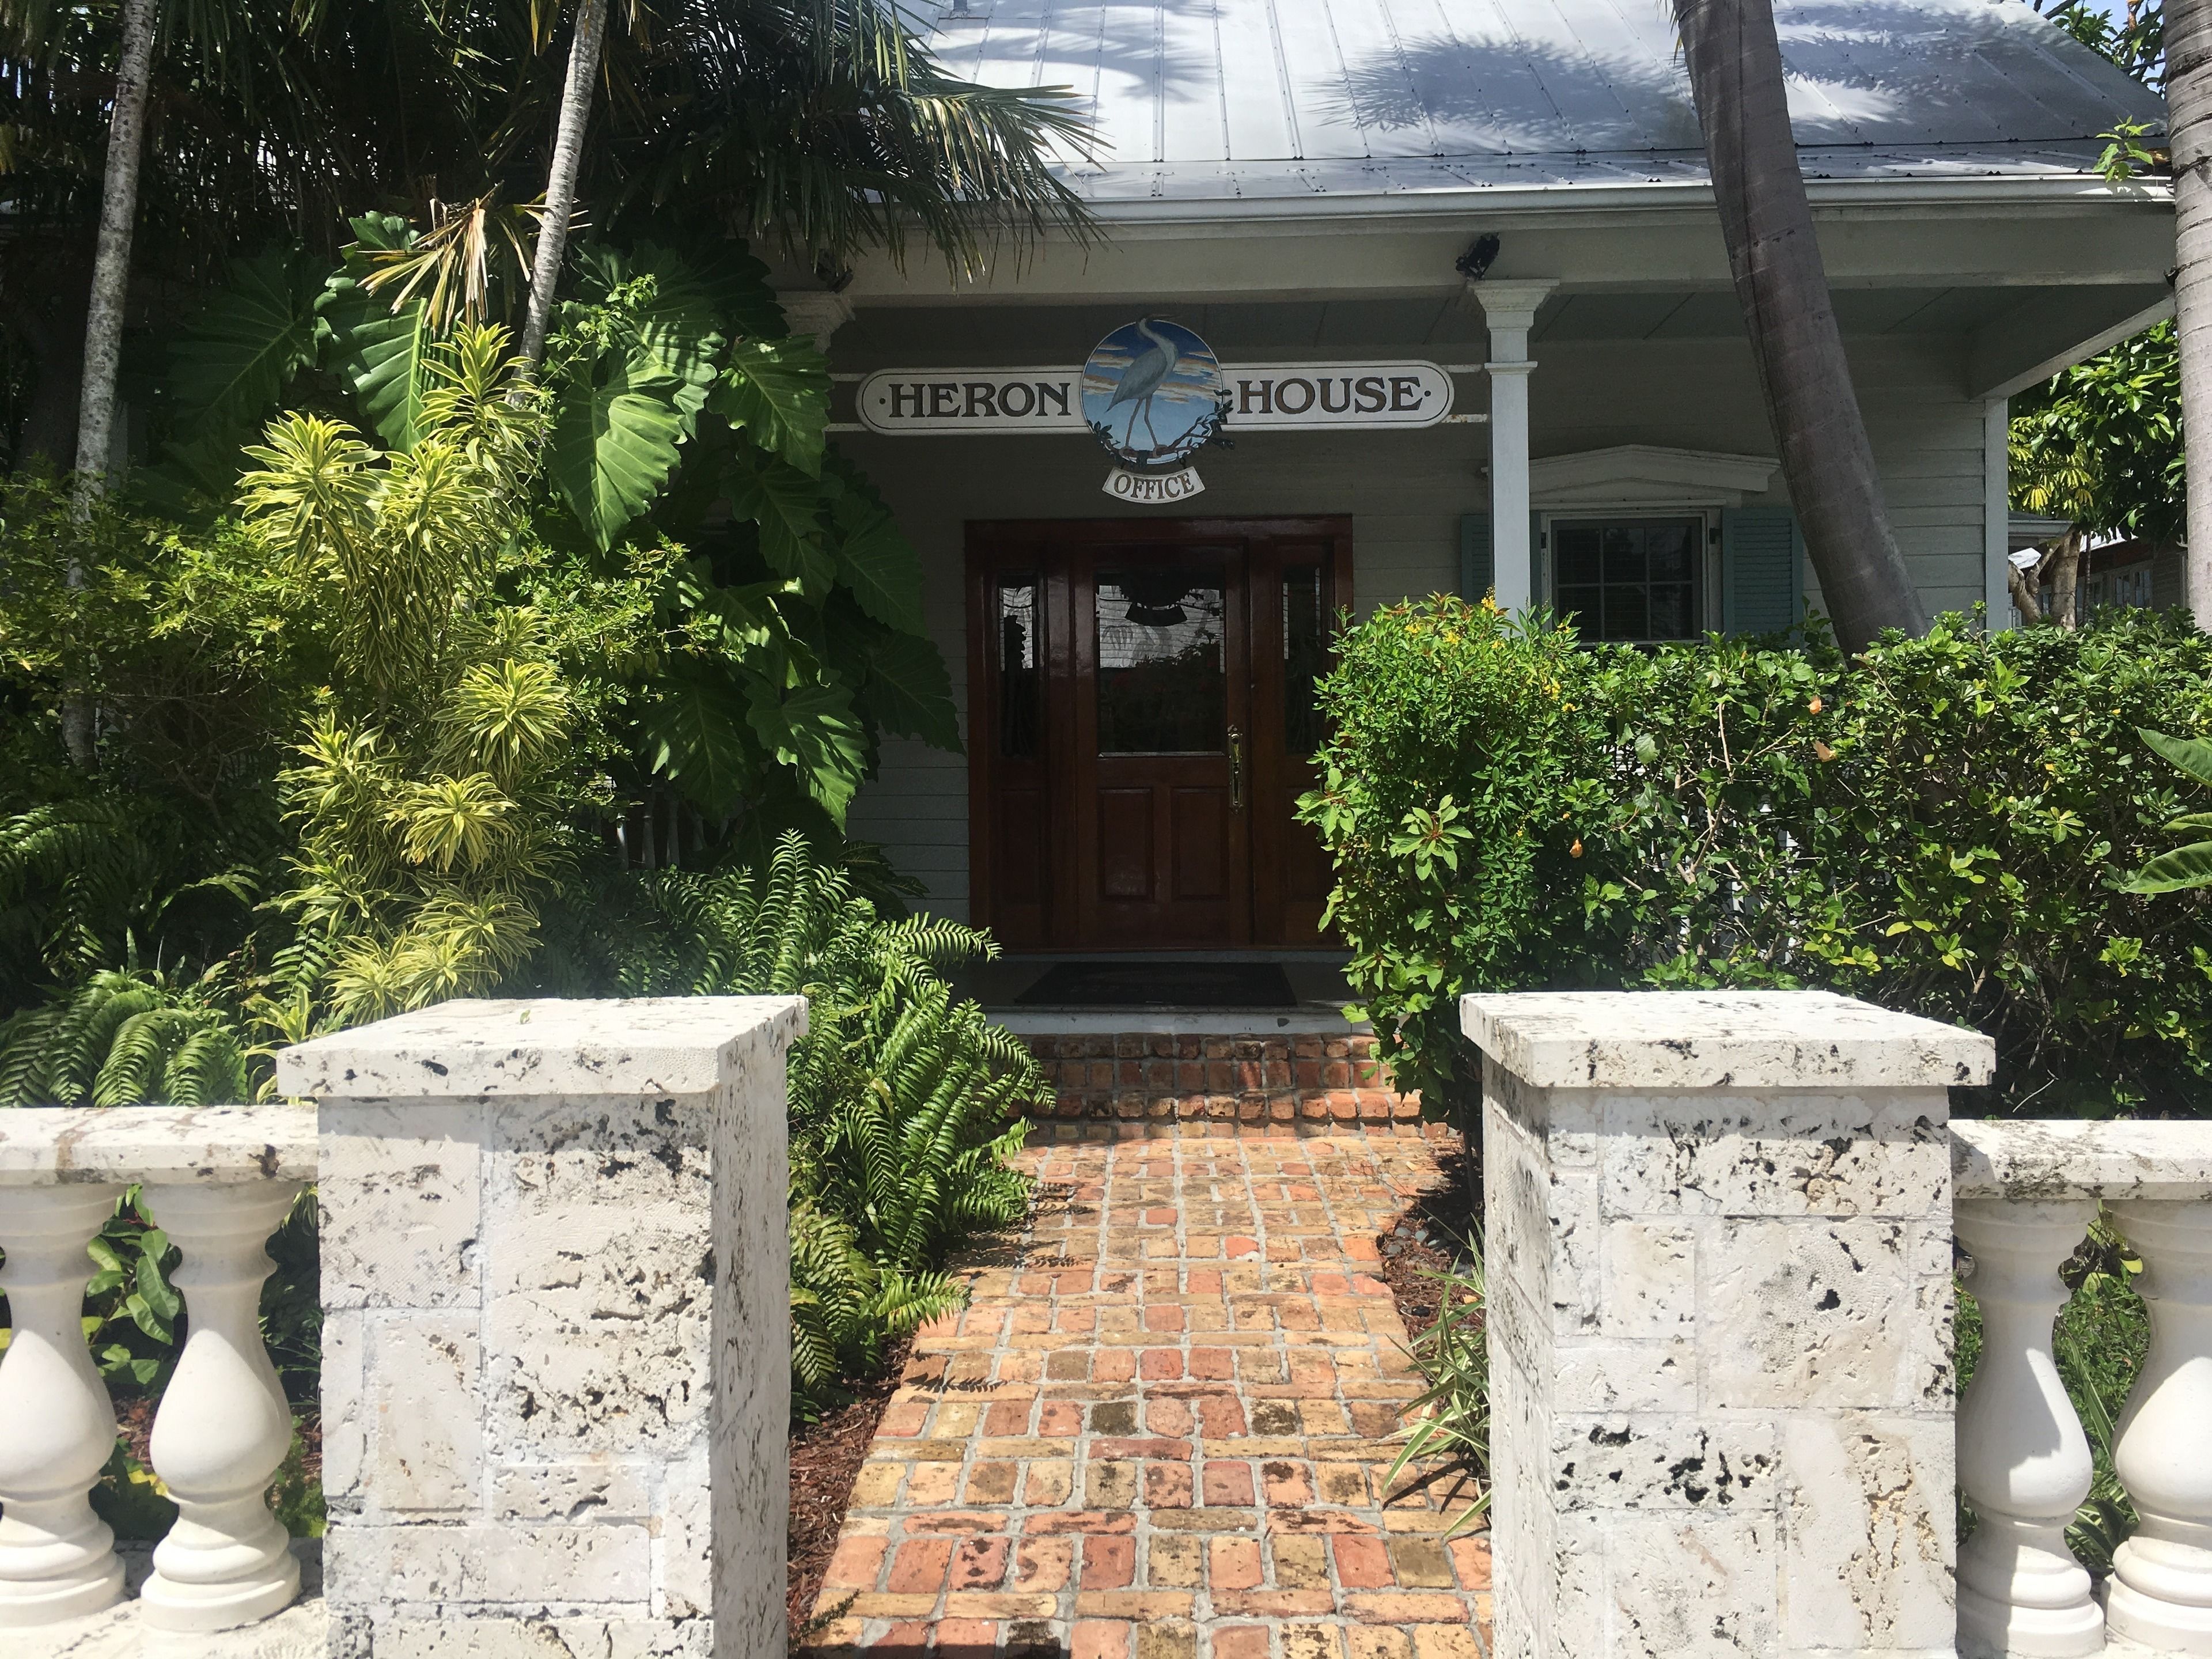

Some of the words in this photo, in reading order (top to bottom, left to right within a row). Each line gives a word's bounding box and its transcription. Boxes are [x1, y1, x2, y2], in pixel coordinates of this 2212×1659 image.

[888, 382, 1071, 418] HERON
[1237, 377, 1423, 415] HOUSE
[1113, 472, 1195, 499] OFFICE
